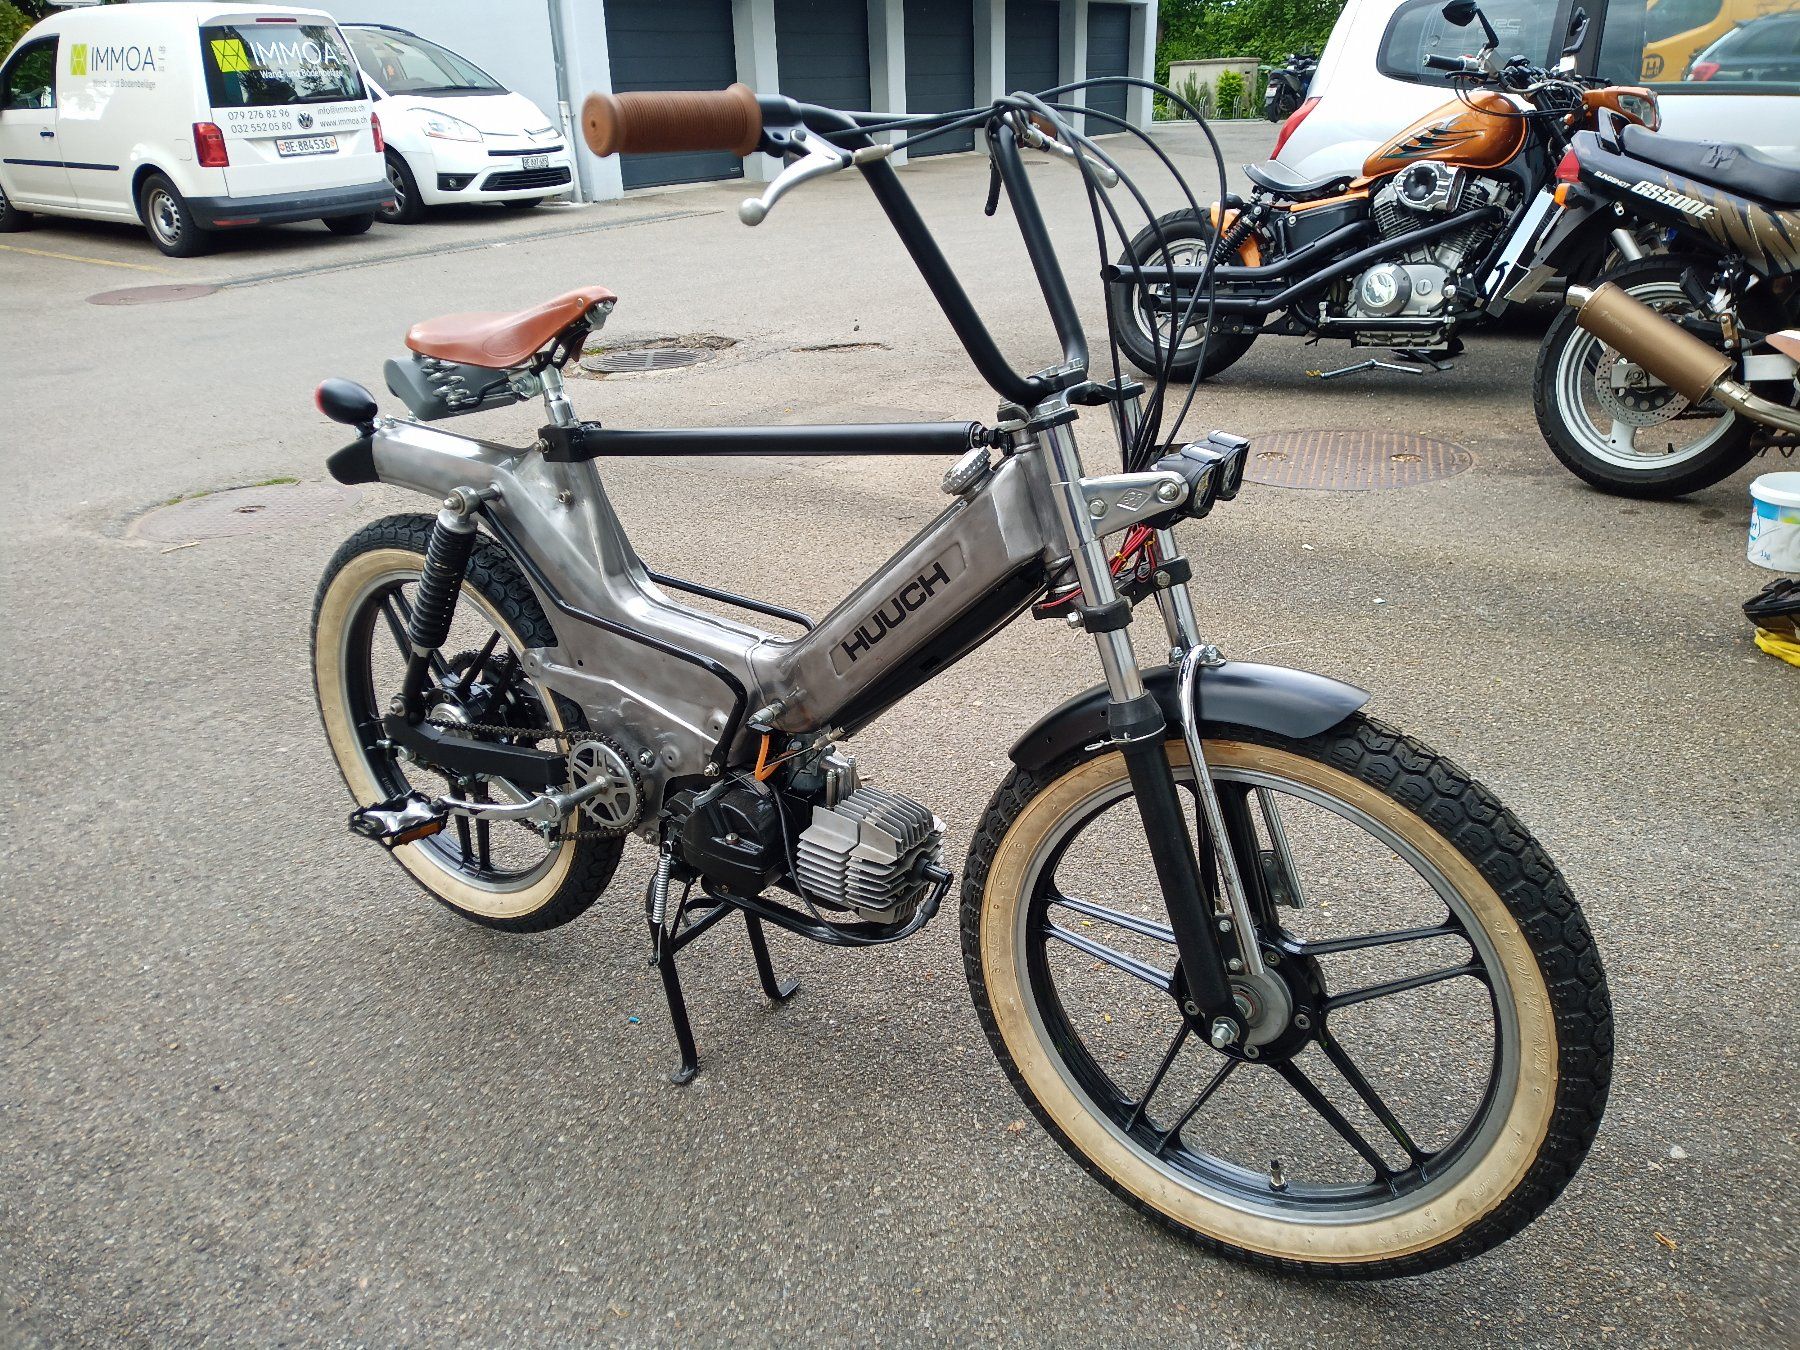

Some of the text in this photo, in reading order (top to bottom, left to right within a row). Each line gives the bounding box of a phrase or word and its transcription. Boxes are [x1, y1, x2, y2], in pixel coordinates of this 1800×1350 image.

[90, 46, 156, 71] IMMOA
[249, 41, 341, 67] IMMOA
[227, 108, 290, 121] 079 276 82 96
[319, 116, 368, 128] www.immoa.ch
[230, 121, 292, 134] 032 552 05 80
[1631, 180, 1719, 220] GS500E
[841, 561, 951, 663] HUUCH
